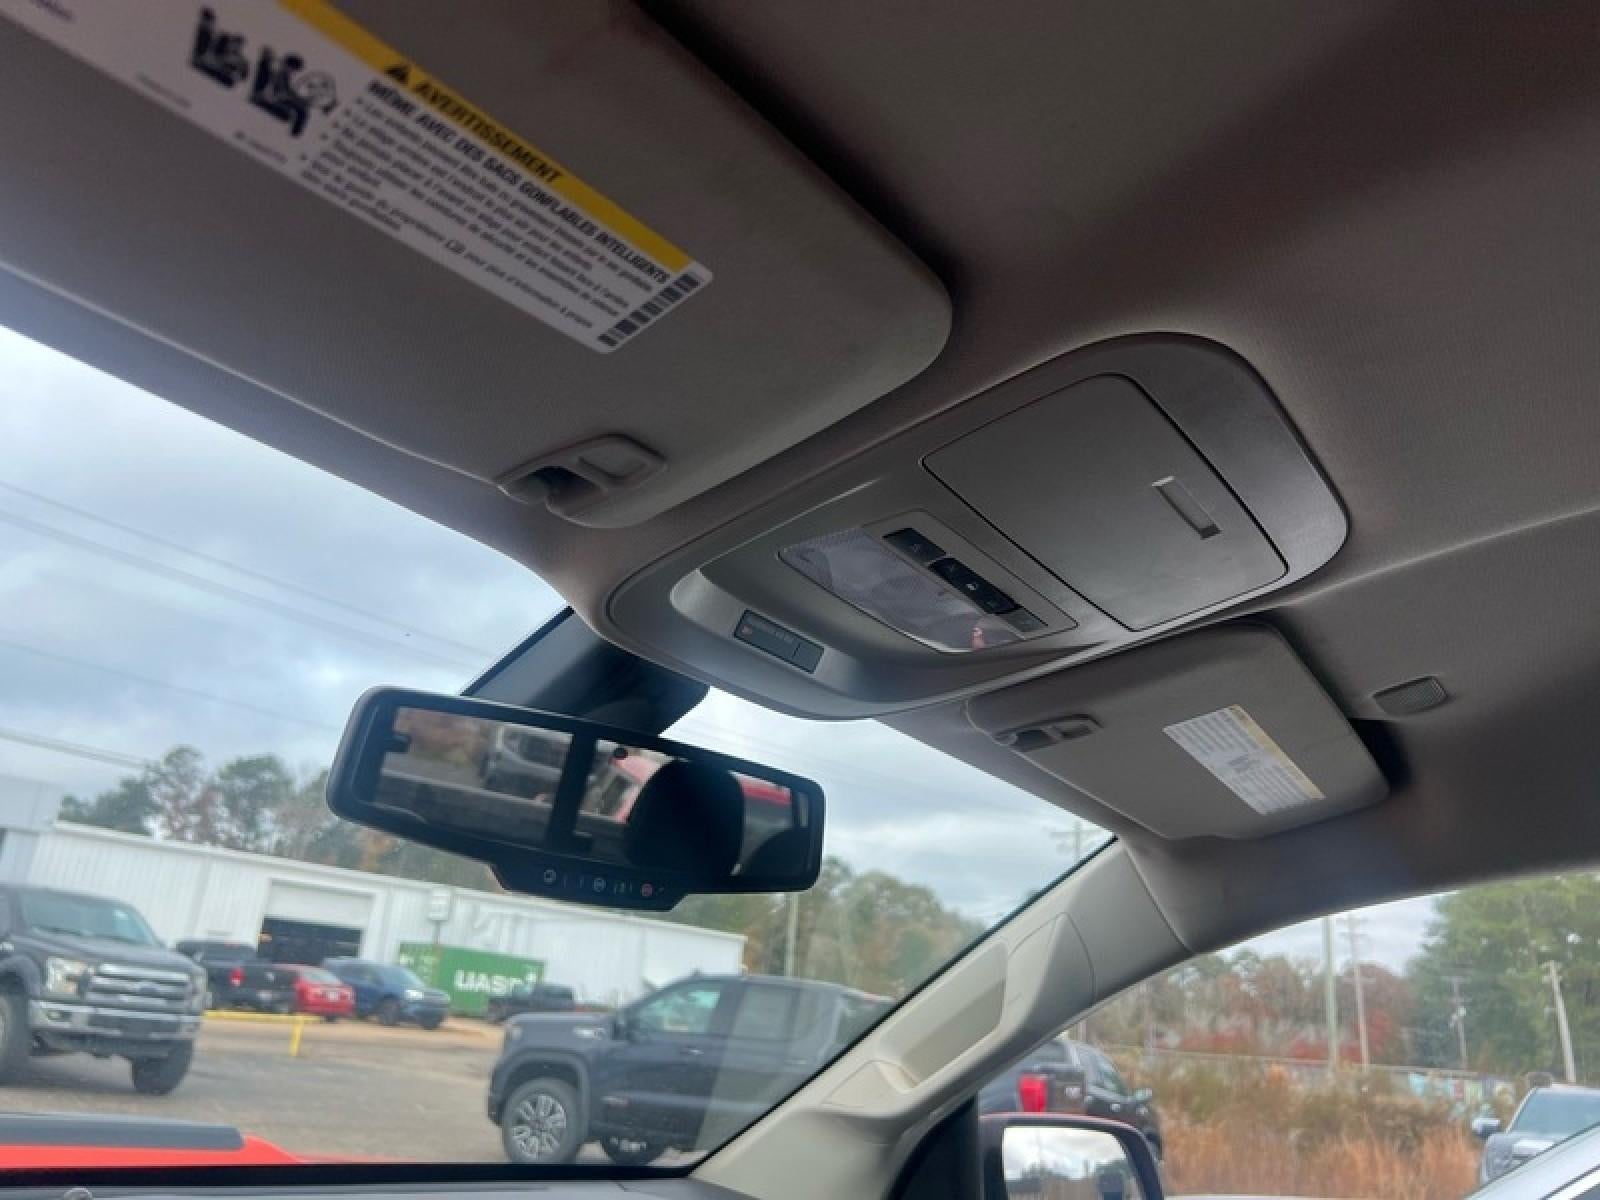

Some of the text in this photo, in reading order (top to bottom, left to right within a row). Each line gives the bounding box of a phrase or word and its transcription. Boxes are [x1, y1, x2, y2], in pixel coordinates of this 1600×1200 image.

[413, 81, 563, 184] AVERTISSEMENT
[416, 114, 458, 144] AVEC
[455, 138, 486, 163] DES
[483, 157, 523, 186] SACS
[519, 181, 598, 236] GONFLABLES
[595, 231, 671, 285] INTELLIGENTS
